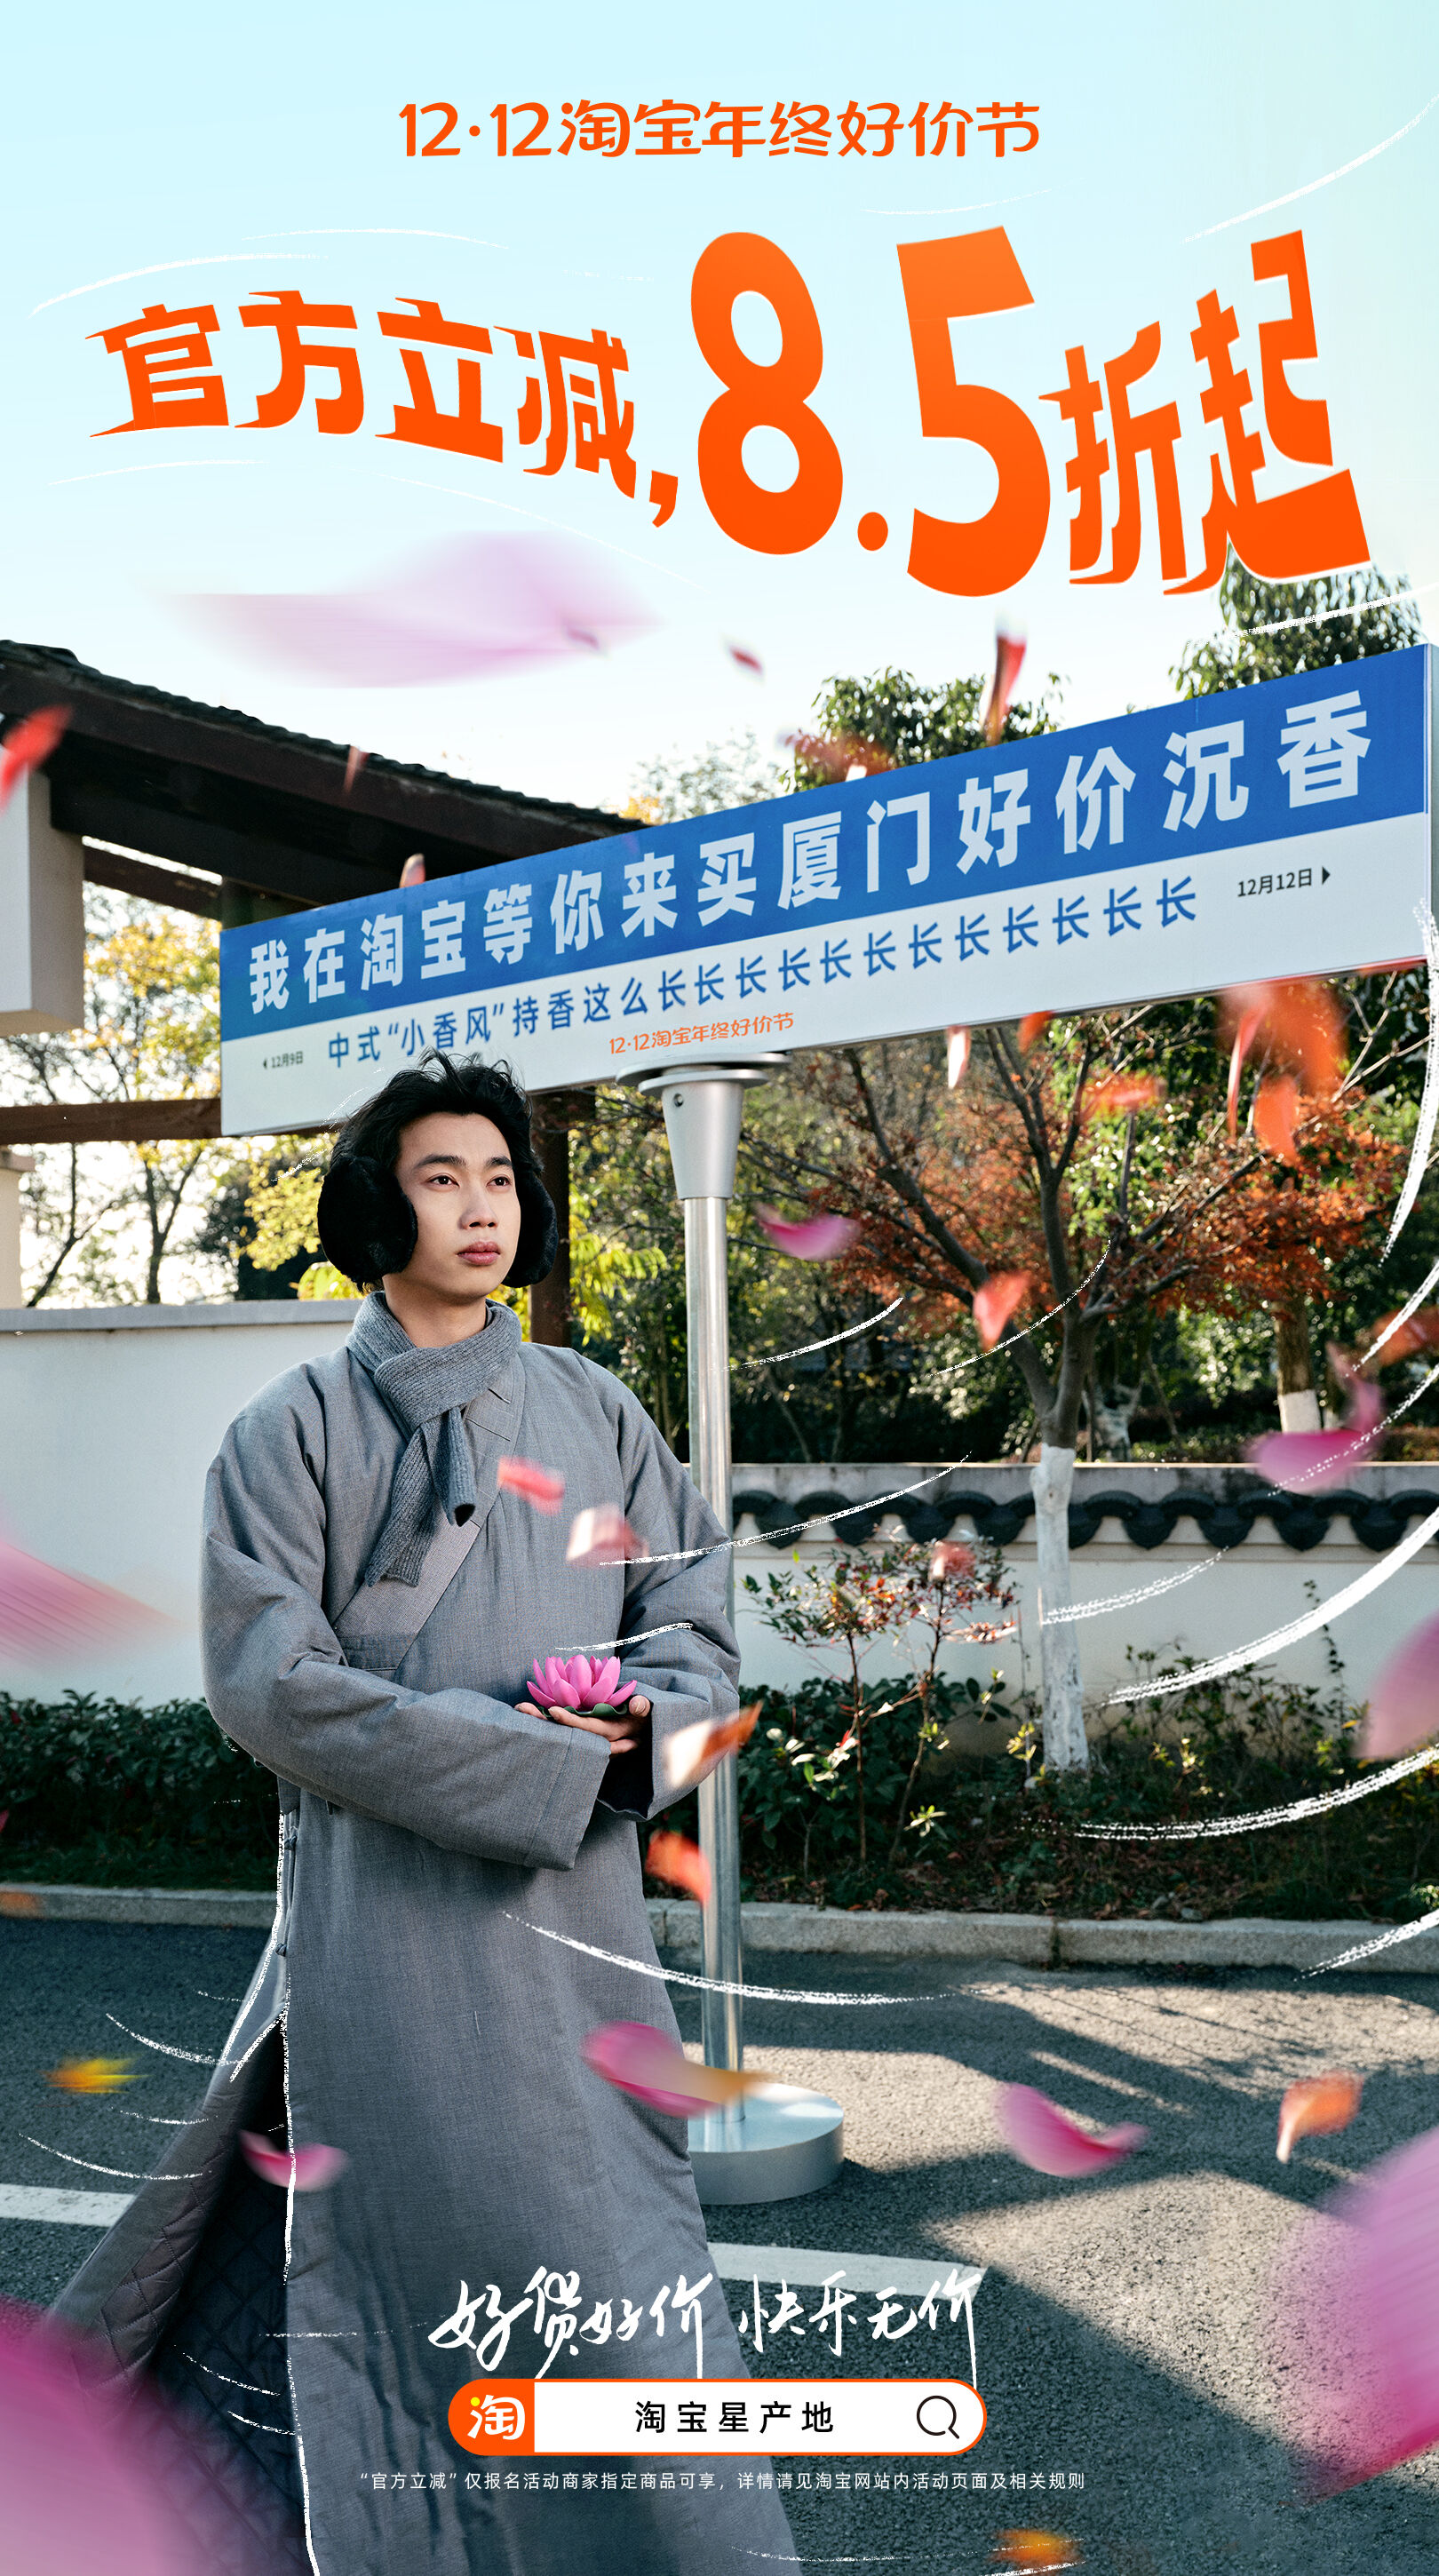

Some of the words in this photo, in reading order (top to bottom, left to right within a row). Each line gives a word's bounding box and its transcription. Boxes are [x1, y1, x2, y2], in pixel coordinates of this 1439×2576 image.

[249, 689, 1371, 1014] 我在淘宝等你来买厦门好价沉香
[1237, 867, 1313, 897] 12月12日
[272, 1051, 303, 1068] 12月9日
